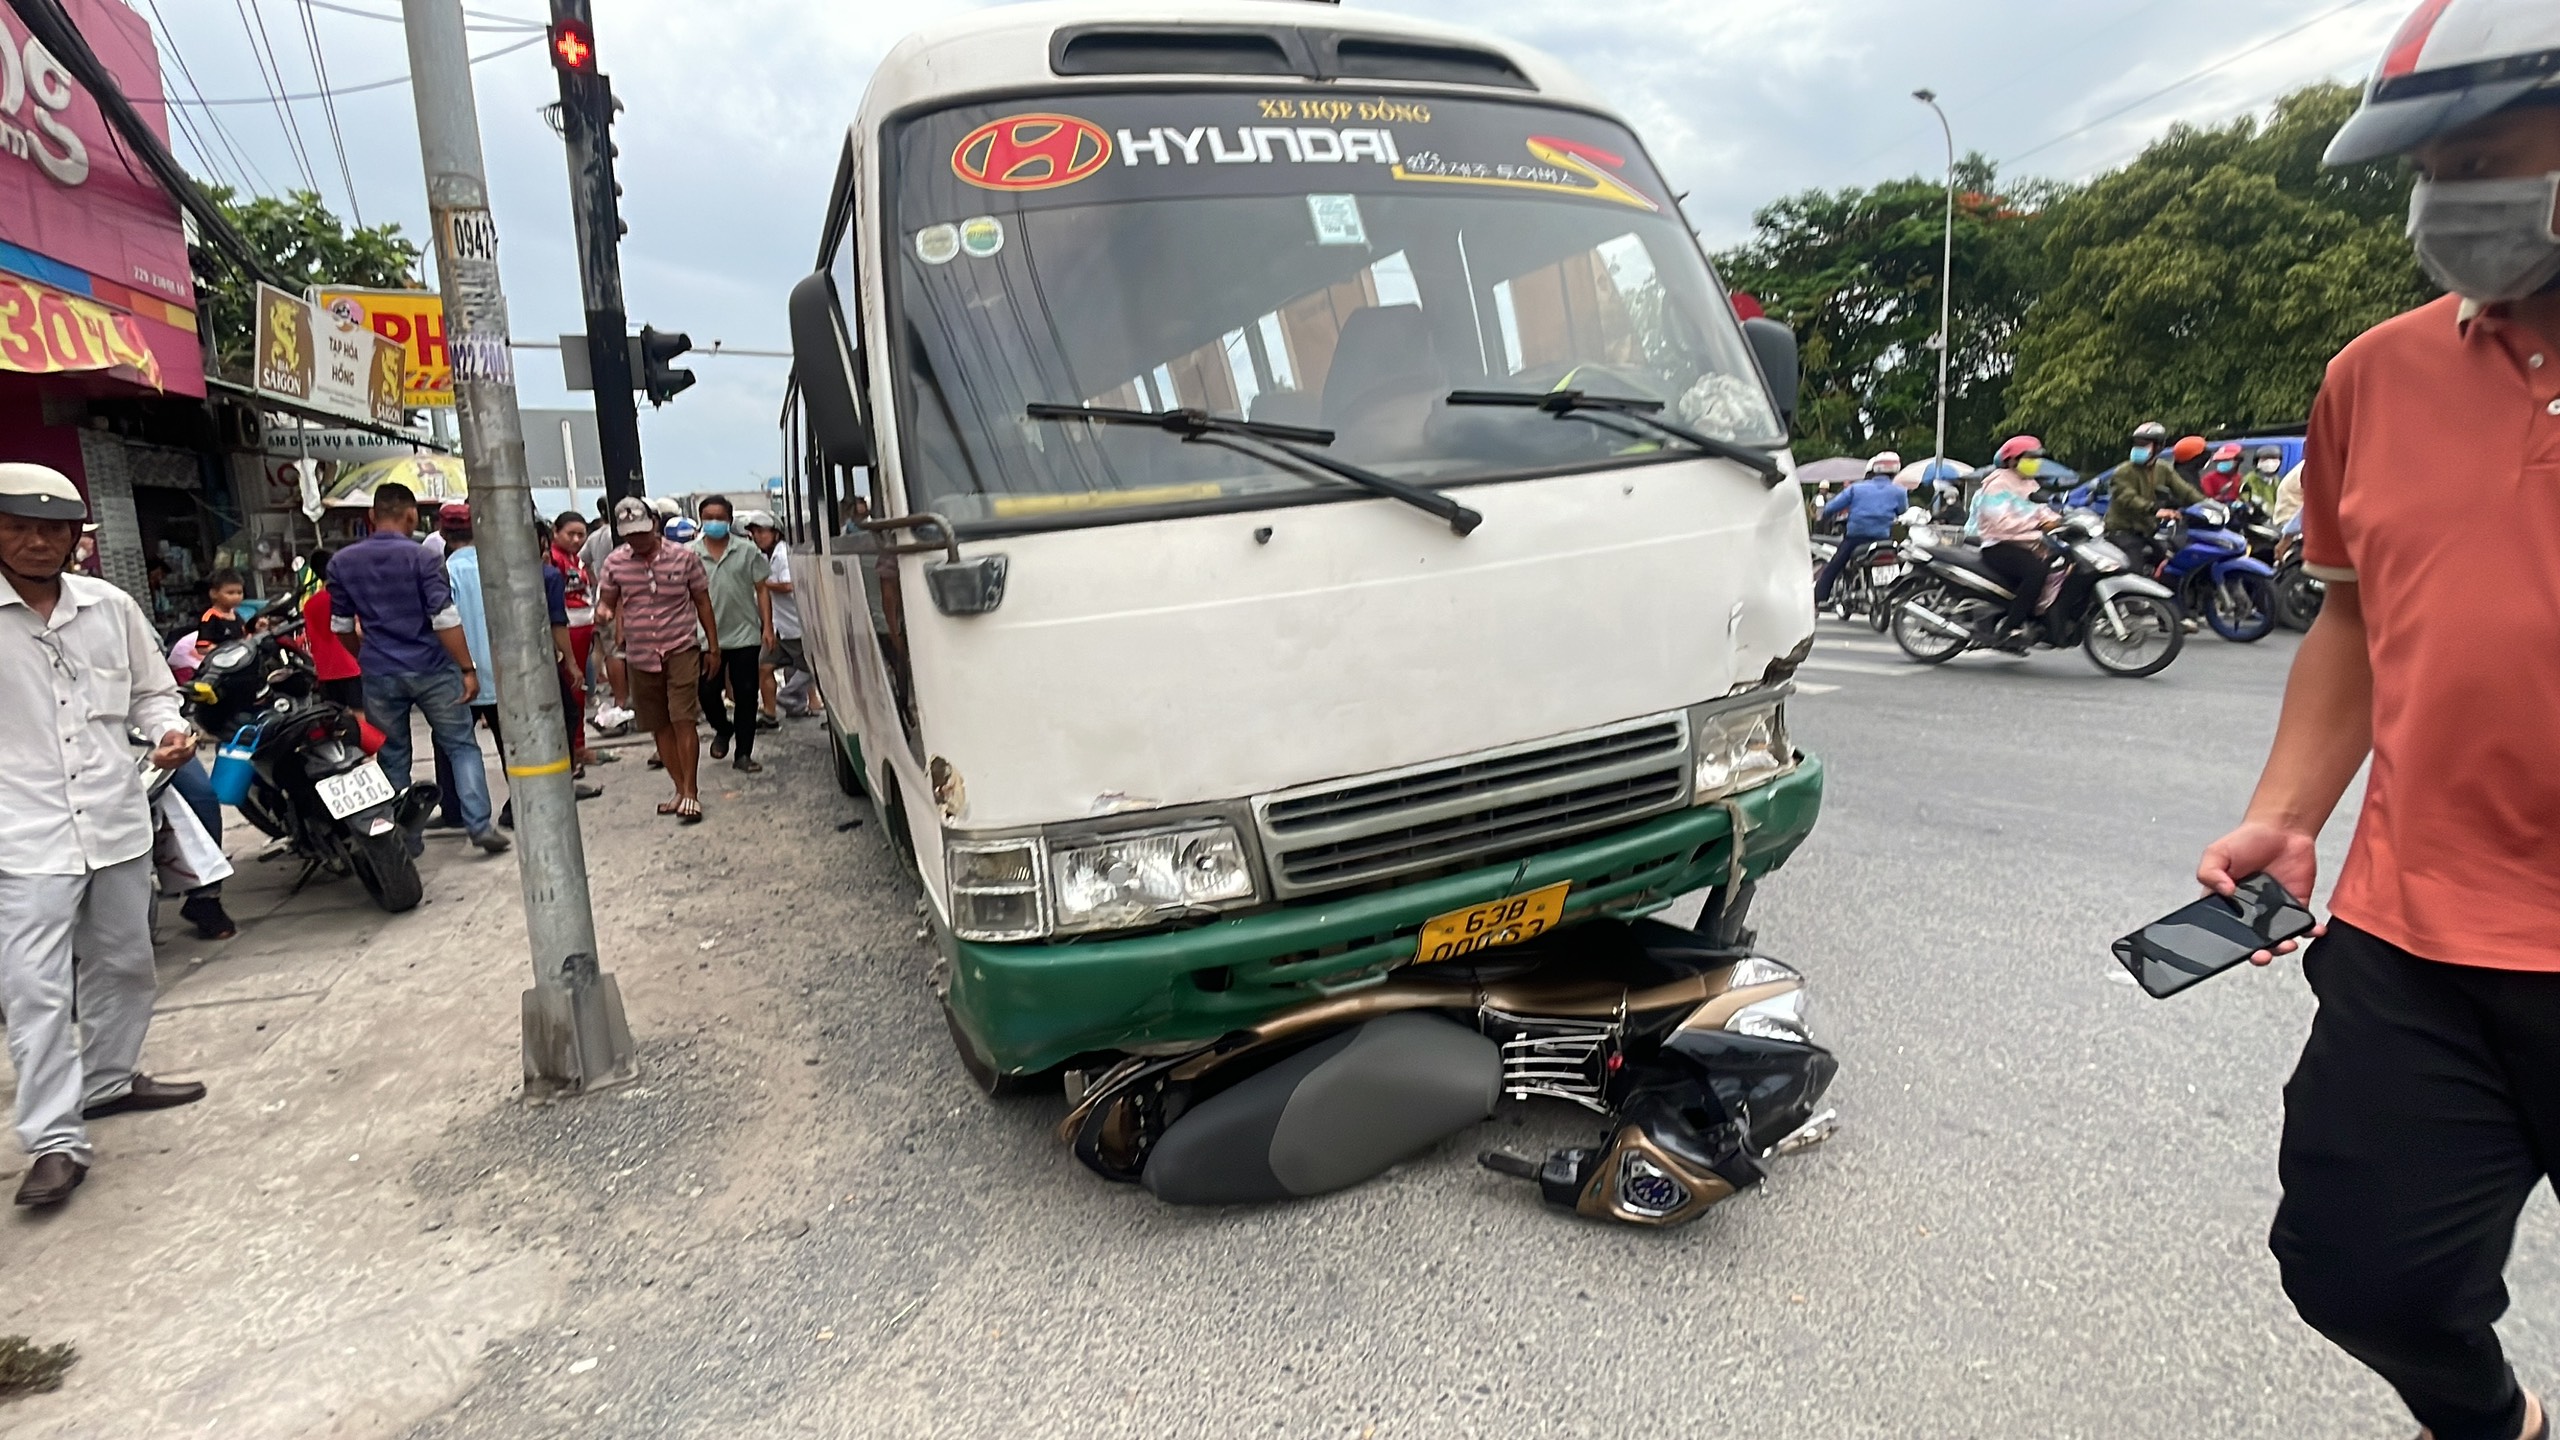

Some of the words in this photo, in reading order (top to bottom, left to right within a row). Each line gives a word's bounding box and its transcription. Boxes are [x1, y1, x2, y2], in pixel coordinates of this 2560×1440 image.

[1257, 99, 1297, 119] XE
[1117, 126, 1400, 166] HYUNDAI
[372, 313, 452, 367] PH
[1466, 899, 1528, 934] 63B
